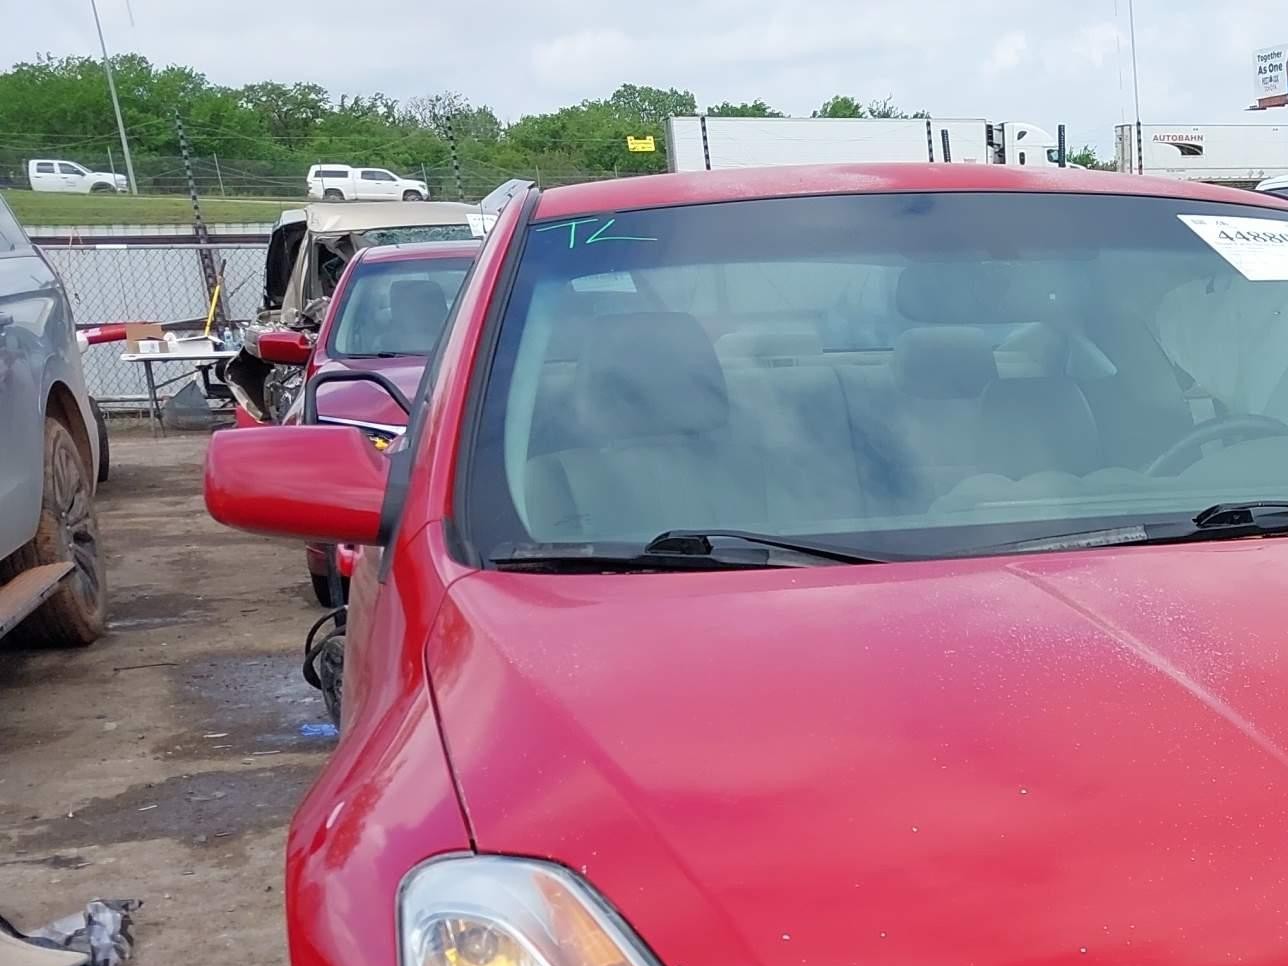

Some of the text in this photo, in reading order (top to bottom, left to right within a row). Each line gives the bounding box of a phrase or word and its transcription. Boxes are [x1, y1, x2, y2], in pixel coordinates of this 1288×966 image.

[1257, 51, 1282, 63] Together
[1258, 63, 1283, 76] As One
[1152, 134, 1203, 142] AUTOBAHN
